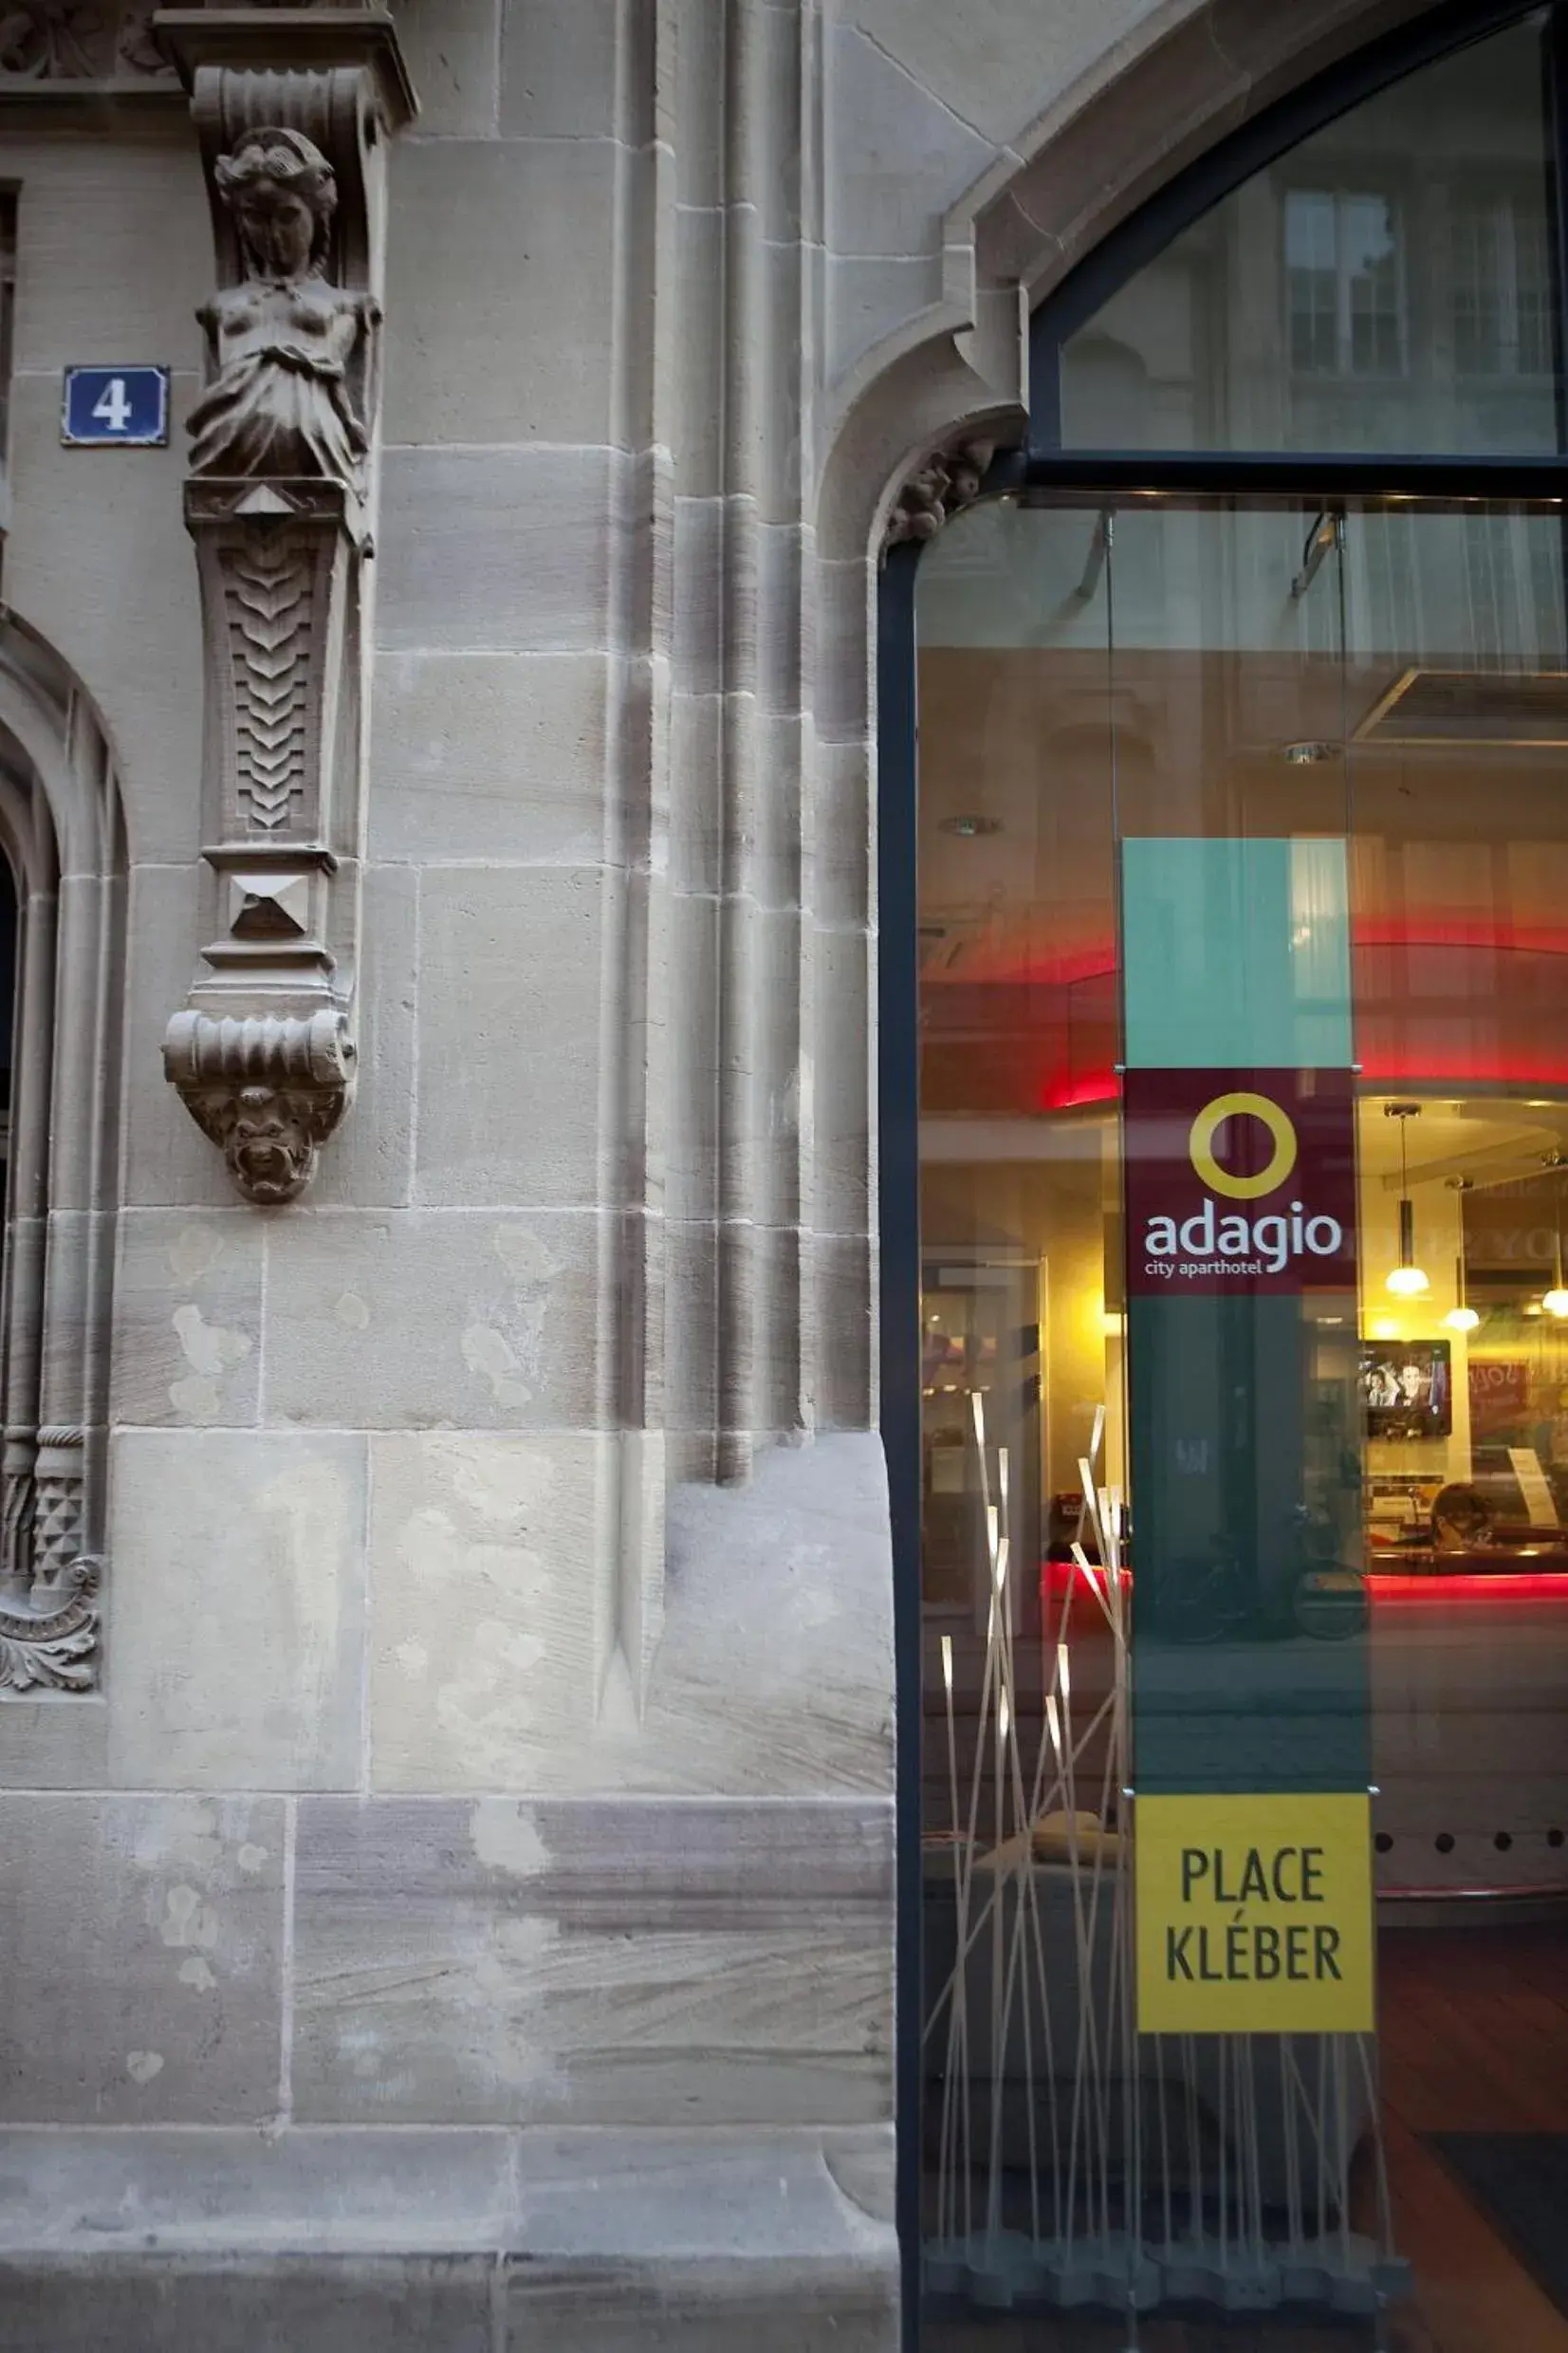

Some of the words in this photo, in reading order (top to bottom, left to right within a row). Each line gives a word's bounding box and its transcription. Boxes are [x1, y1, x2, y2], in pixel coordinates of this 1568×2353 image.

[91, 378, 133, 430] 4
[1145, 1198, 1341, 1273] adagio
[1144, 1261, 1175, 1279] city
[1179, 1259, 1264, 1278] aparthotel
[1181, 1846, 1326, 1903] PLACE
[1166, 1906, 1343, 1981] KLÉBER
